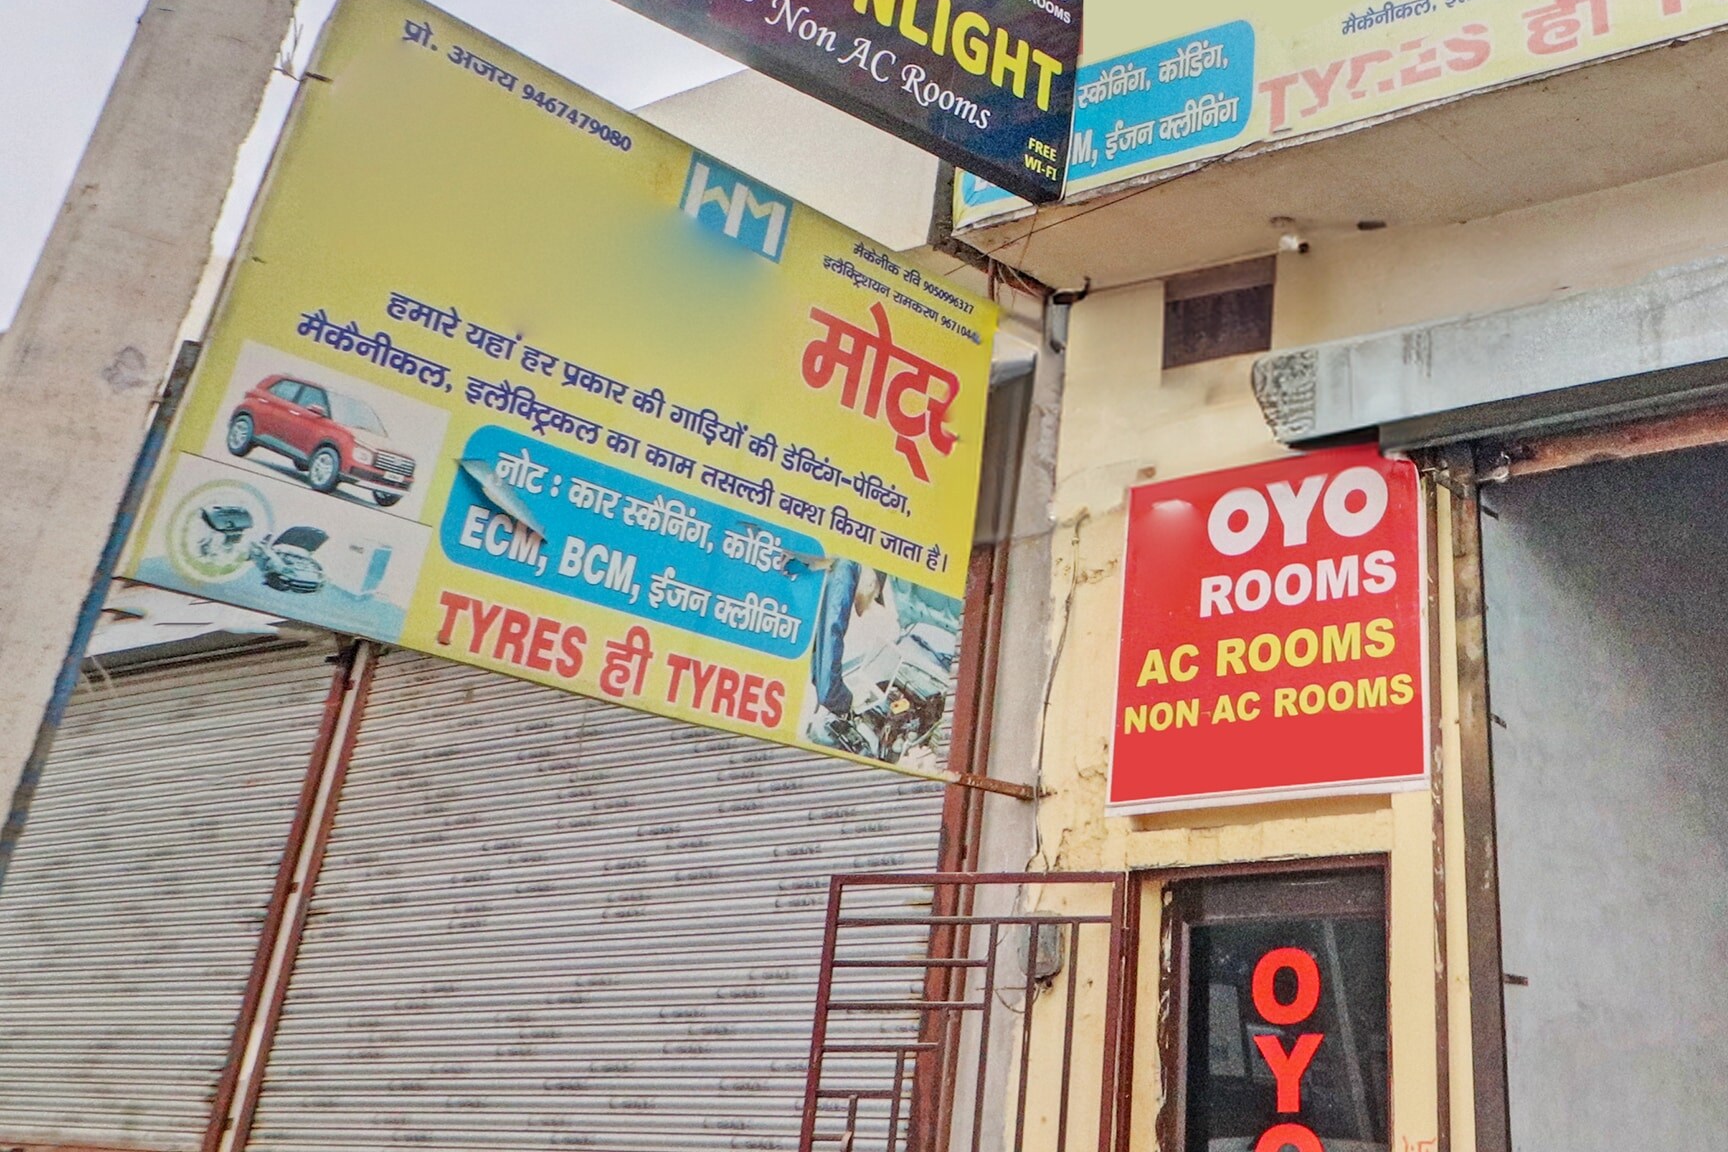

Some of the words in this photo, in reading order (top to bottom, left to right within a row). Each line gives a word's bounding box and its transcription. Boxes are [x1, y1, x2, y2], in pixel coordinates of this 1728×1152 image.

[446, 44, 520, 94] अजय
[521, 83, 634, 153] 9467479080
[838, 37, 898, 83] AC
[901, 63, 994, 130] Rooms
[1023, 154, 1058, 182] WI-FI
[1028, 137, 1057, 162] FREE
[386, 290, 462, 339] हमारे
[520, 344, 560, 377] हर
[561, 360, 630, 405] प्रकार
[632, 388, 666, 419] की
[748, 432, 779, 463] की
[495, 448, 548, 494] नोट
[567, 476, 624, 521] कार
[606, 428, 641, 460] का
[644, 442, 698, 480] काम
[700, 462, 776, 509] तसल्ली
[829, 504, 878, 545] किया
[879, 530, 925, 564] जाता
[1206, 465, 1390, 557] OYO
[458, 504, 549, 576] ECM,
[557, 535, 641, 605] BCM,
[1198, 549, 1398, 619] ROOMS
[437, 590, 588, 680] TYRES
[599, 624, 654, 698] ही
[665, 652, 786, 729] TYRES
[1136, 642, 1200, 688] AC
[1215, 617, 1397, 679] ROOMS
[1122, 697, 1200, 736] NON
[1210, 689, 1262, 727] AC
[1272, 673, 1416, 718] ROOMS
